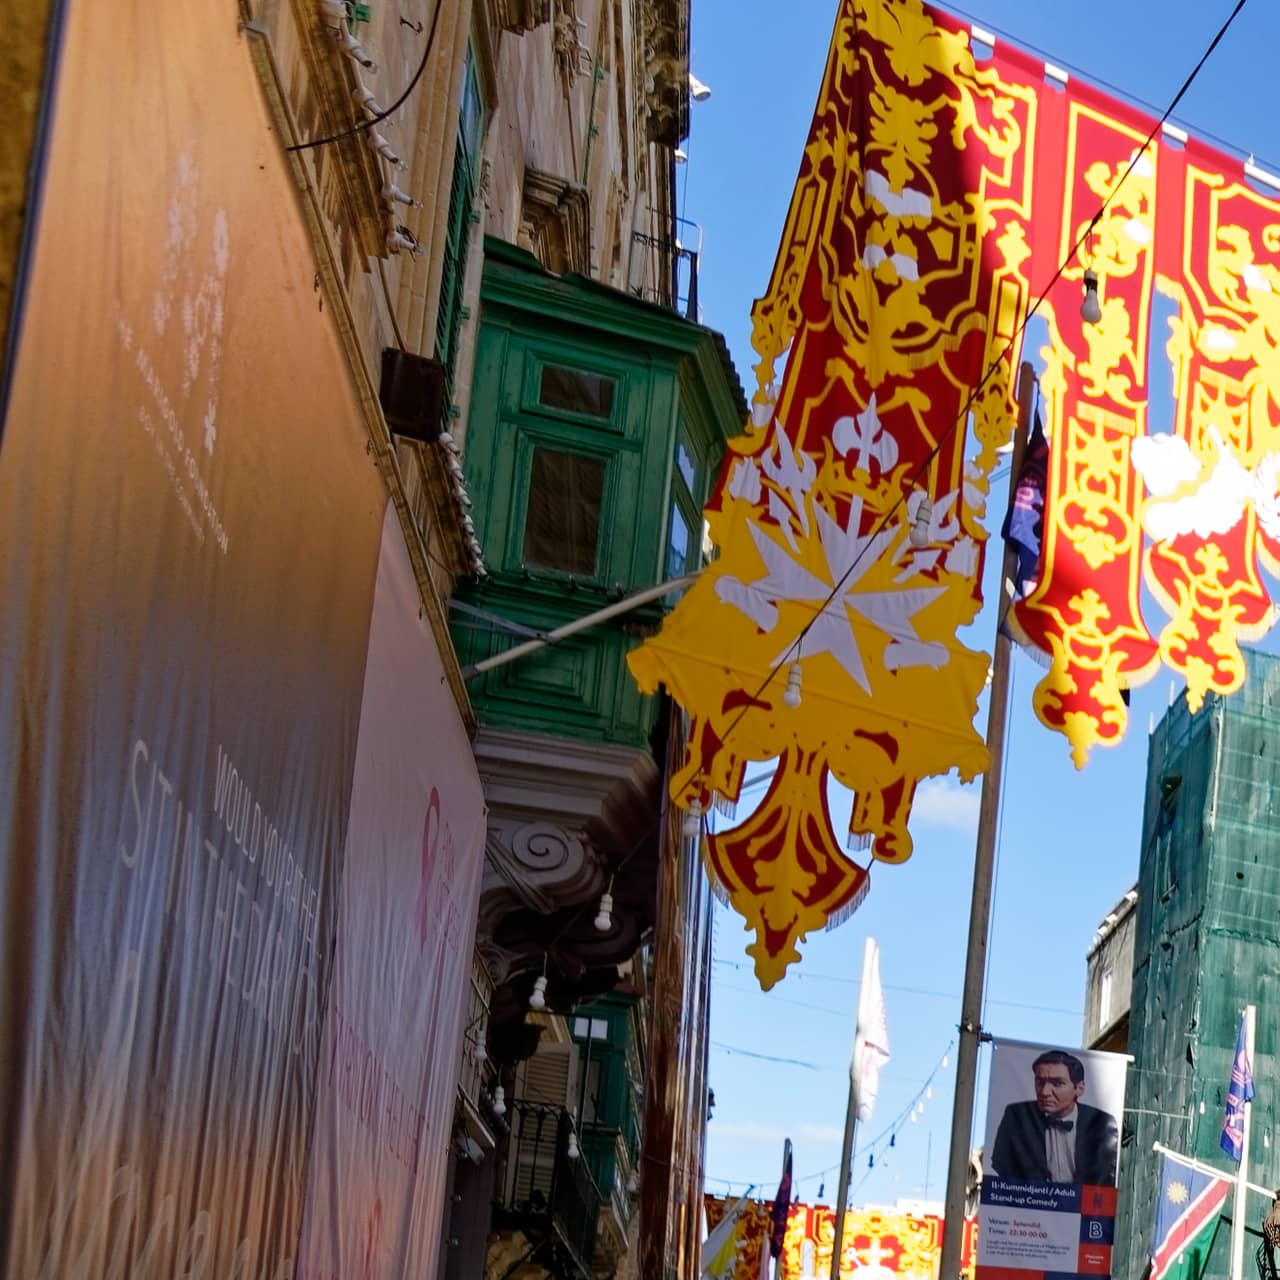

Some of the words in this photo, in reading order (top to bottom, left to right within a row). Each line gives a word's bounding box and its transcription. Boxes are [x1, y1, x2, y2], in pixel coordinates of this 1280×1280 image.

[213, 743, 261, 864] WOULD
[261, 815, 289, 898] YOU
[990, 1193, 1025, 1204] Stand-up
[1026, 1196, 1058, 1208] Comedy
